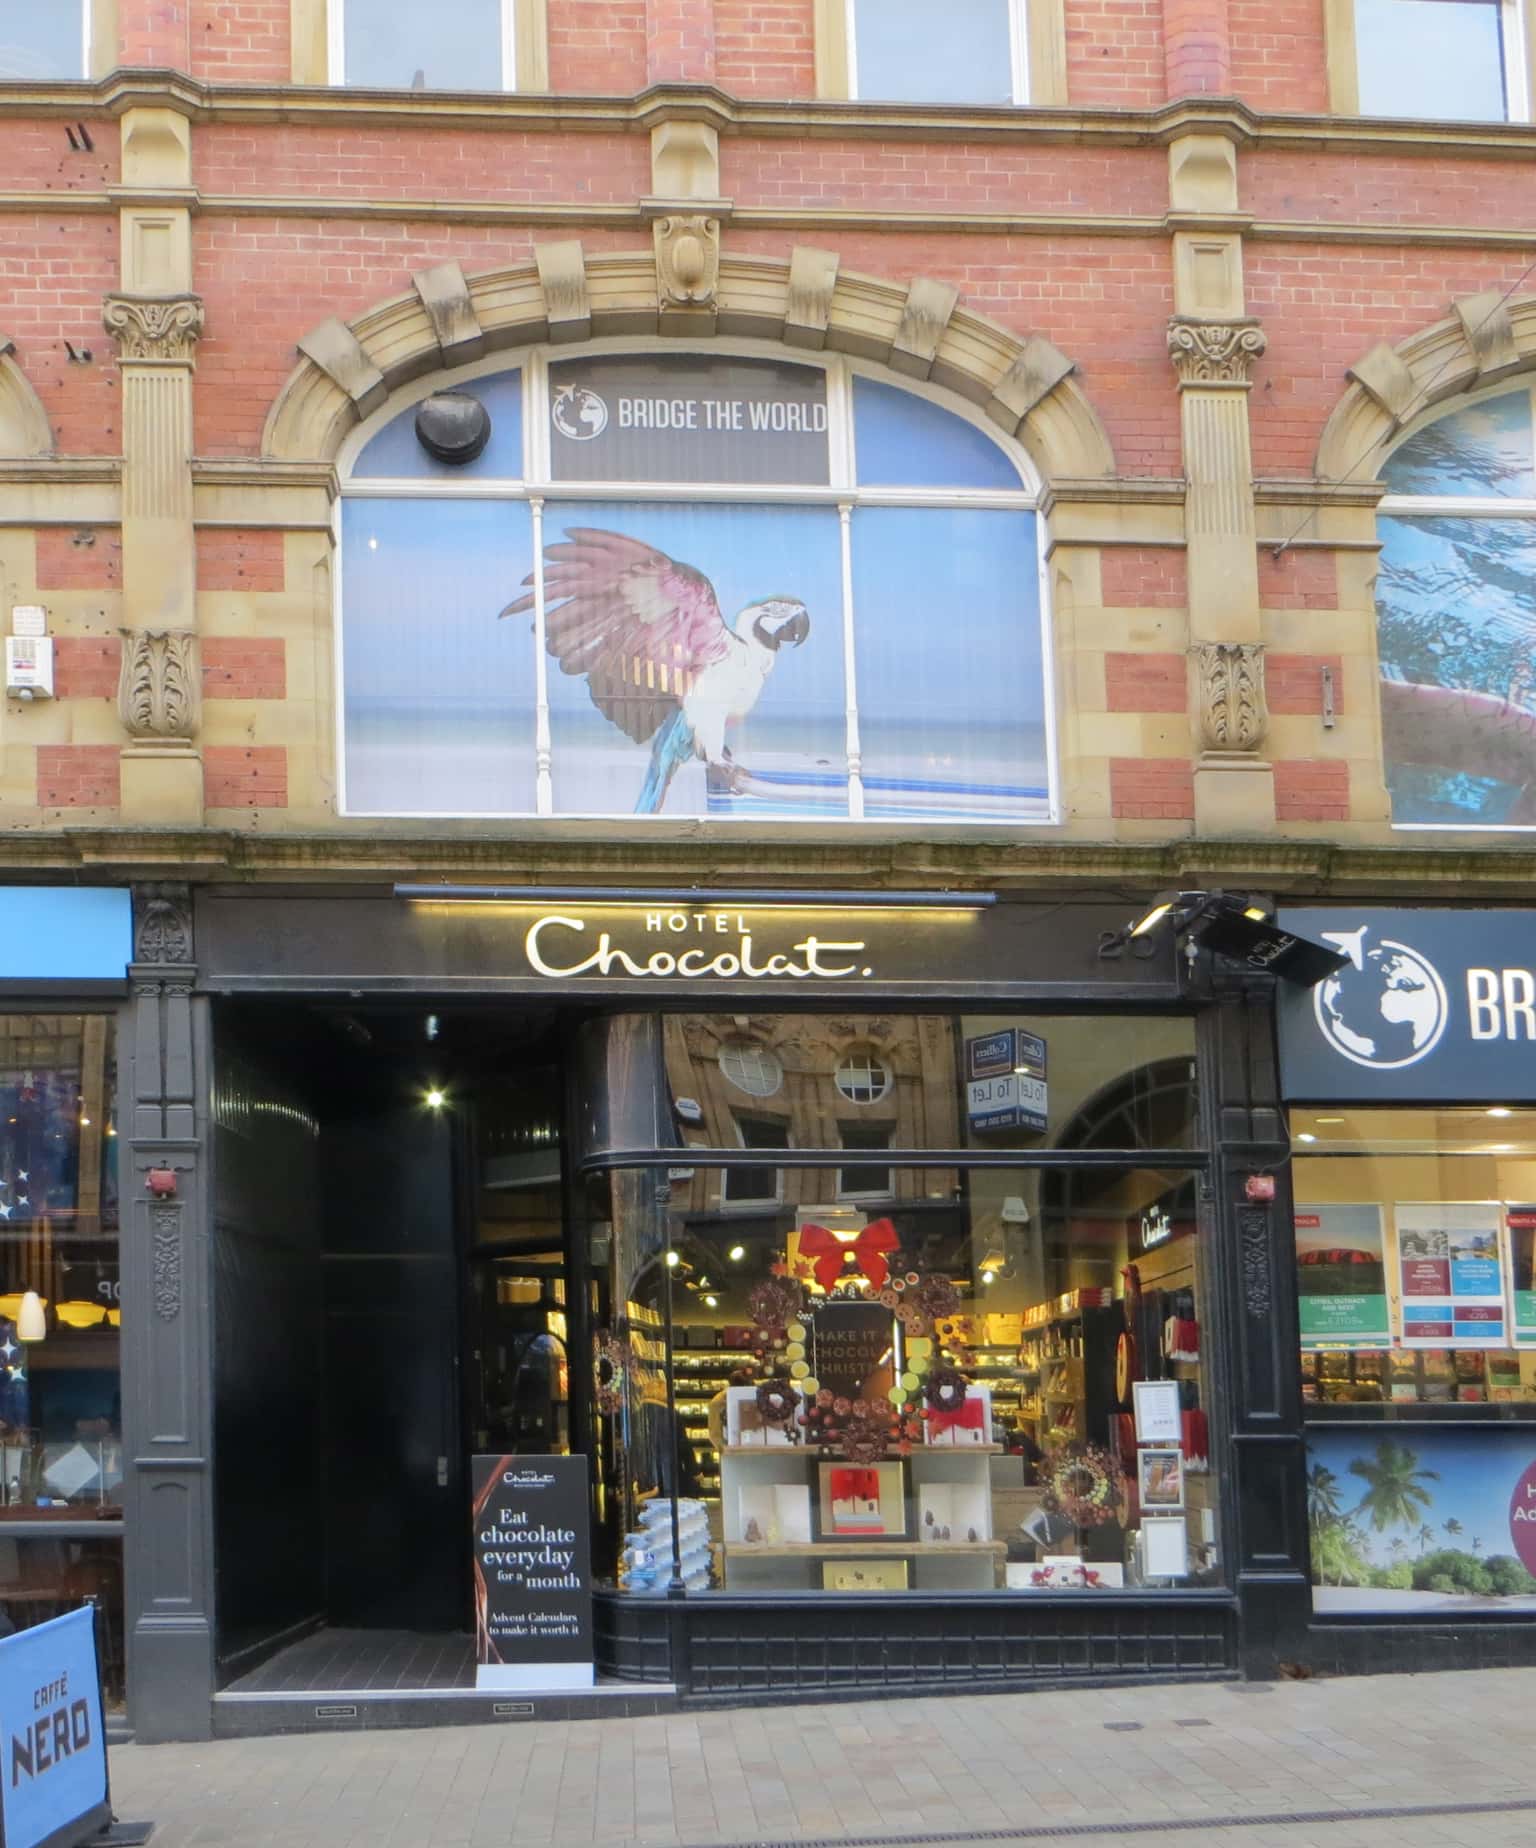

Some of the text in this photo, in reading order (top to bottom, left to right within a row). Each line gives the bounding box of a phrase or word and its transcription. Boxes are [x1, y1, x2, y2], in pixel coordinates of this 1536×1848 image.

[618, 398, 828, 432] BRIDGE THE WORLD
[646, 913, 751, 934] HOTEL
[815, 1330, 857, 1342] MAKE
[864, 1330, 878, 1341] IT
[500, 1508, 529, 1524] Eat
[480, 1524, 576, 1543] chocolate
[483, 1545, 574, 1571] everyday
[497, 1569, 581, 1588] for a month
[490, 1611, 578, 1622] Advent Calendars
[489, 1624, 579, 1635] to make it worth it
[12, 1697, 91, 1789] NERO
